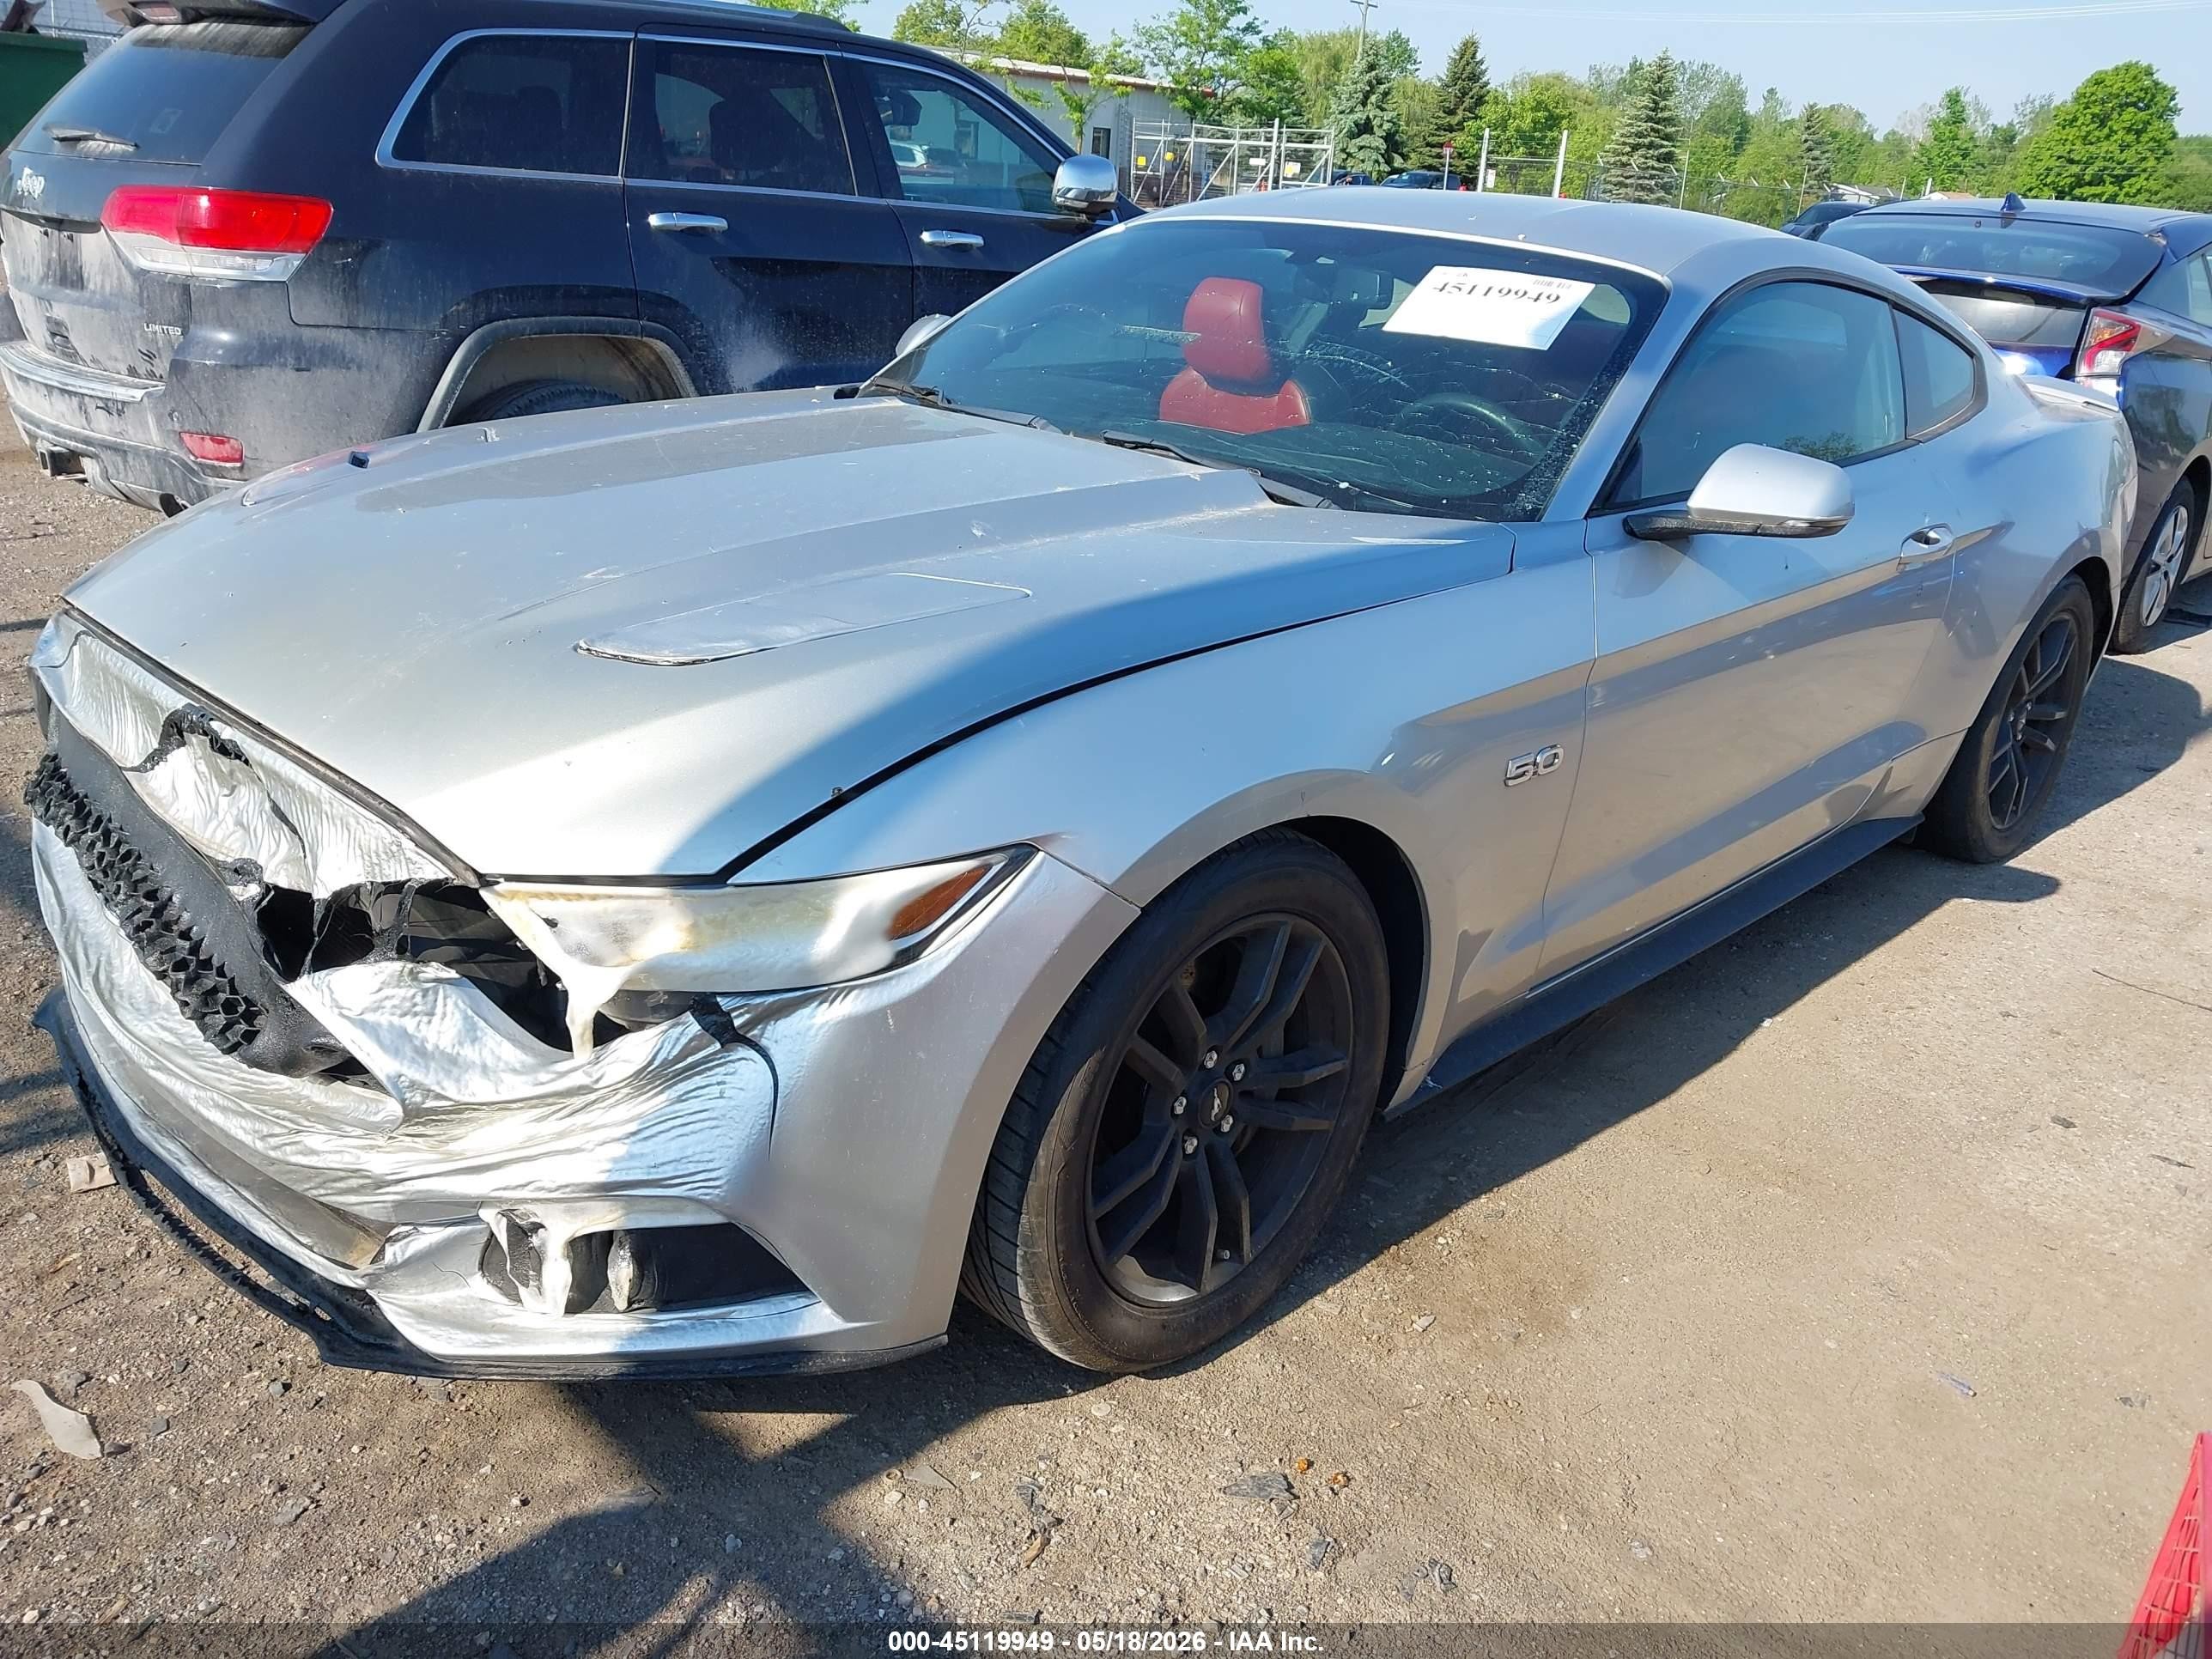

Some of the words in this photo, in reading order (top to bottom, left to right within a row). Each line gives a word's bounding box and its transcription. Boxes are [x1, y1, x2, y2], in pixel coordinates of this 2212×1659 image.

[17, 167, 45, 198] Jeep
[1432, 282, 1561, 304] 45119949
[143, 323, 182, 336] LIMITED
